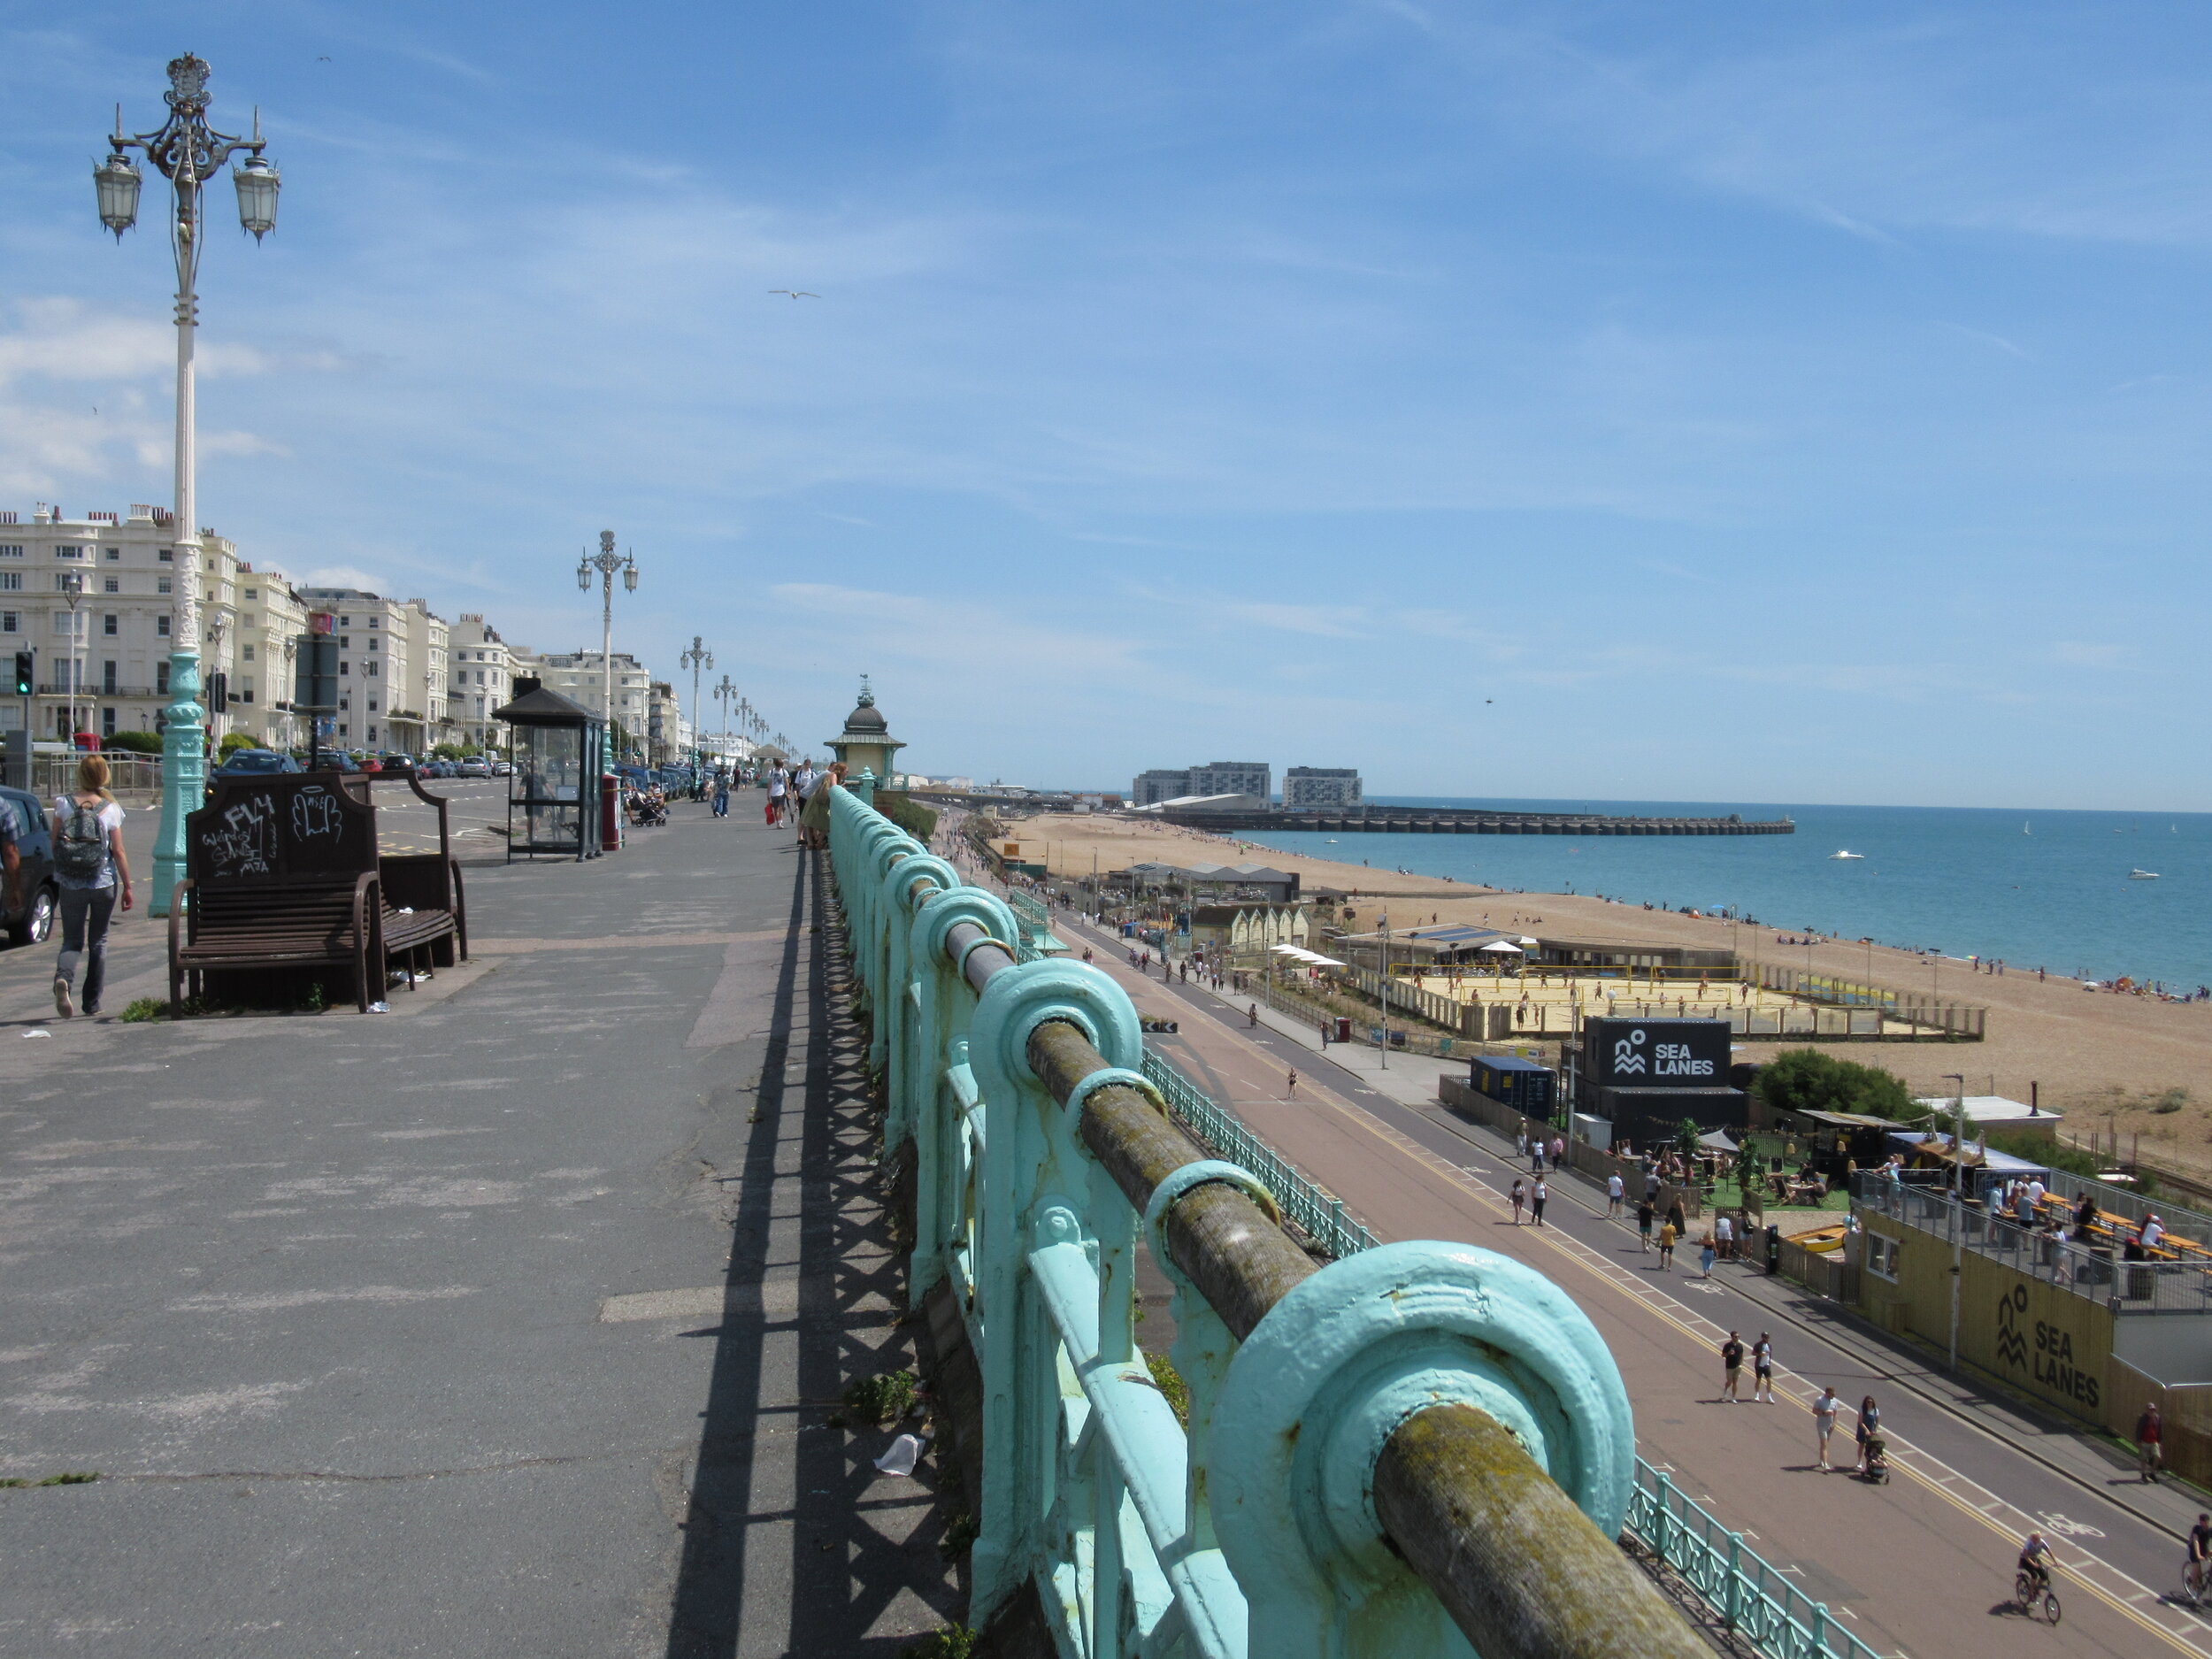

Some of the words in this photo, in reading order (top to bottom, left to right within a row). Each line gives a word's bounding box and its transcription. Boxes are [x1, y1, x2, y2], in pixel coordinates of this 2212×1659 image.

[1655, 1043, 1691, 1059] SEA
[1655, 1059, 1714, 1075] LANES
[2034, 1320, 2073, 1363] SEA
[2034, 1353, 2100, 1409] LANES
